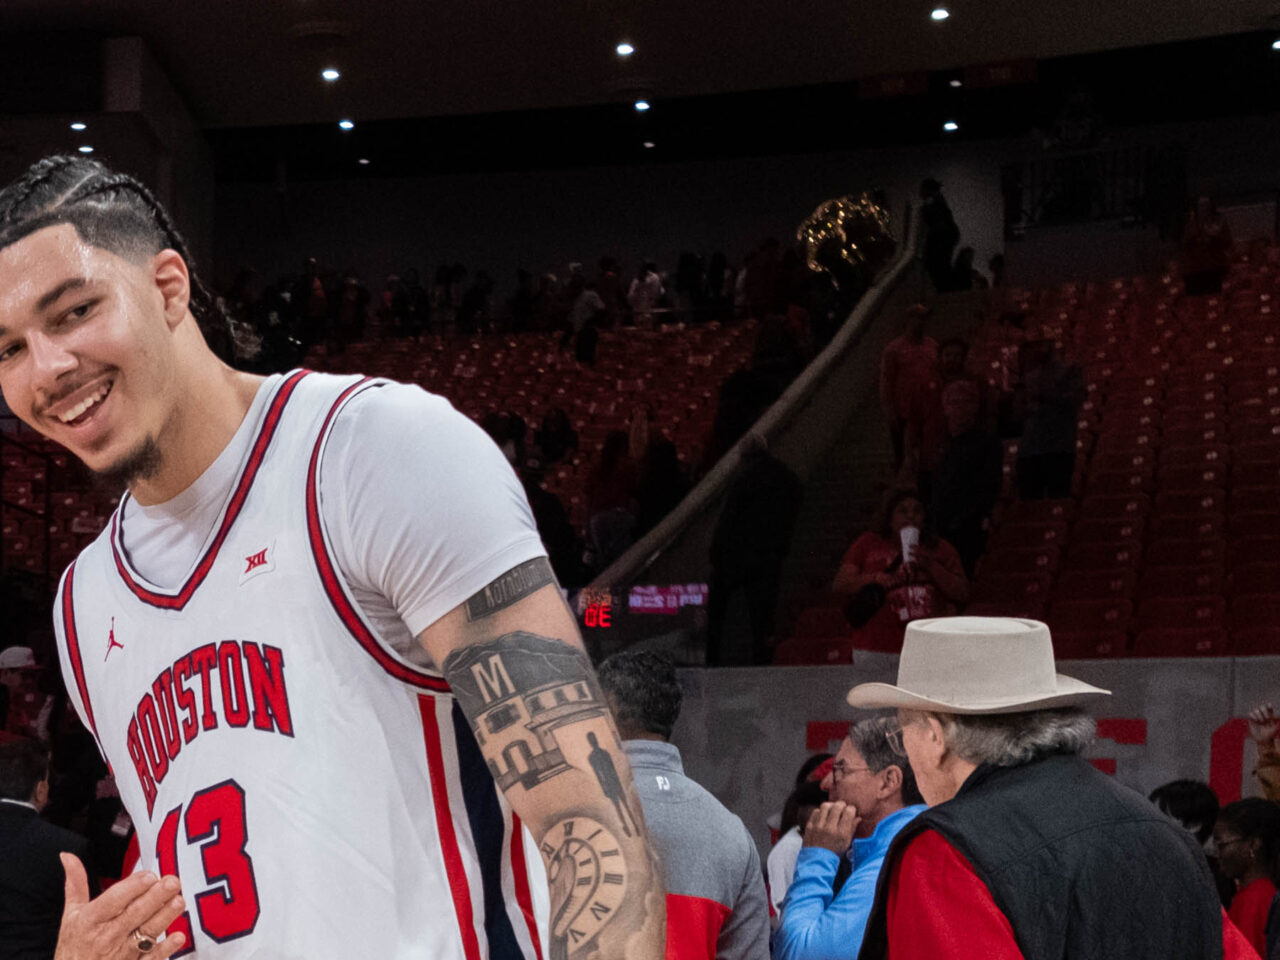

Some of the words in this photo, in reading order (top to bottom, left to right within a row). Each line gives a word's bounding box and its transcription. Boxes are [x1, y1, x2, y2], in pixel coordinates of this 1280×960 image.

[126, 640, 295, 822] HOUSTON
[471, 653, 517, 704] M
[156, 778, 261, 960] 13
